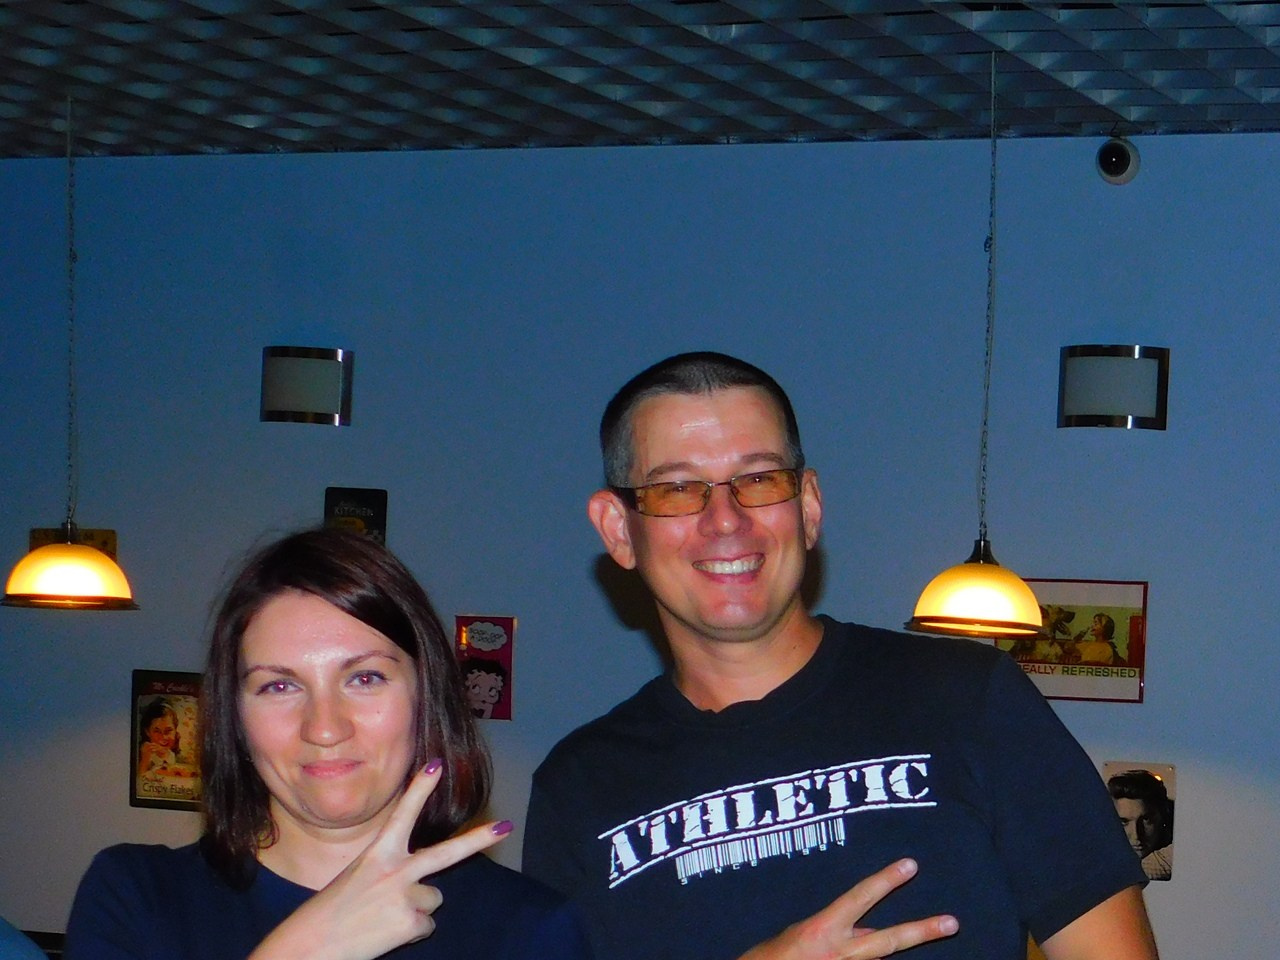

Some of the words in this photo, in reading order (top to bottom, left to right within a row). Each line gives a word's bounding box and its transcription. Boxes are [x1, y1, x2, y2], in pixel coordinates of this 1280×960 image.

[1061, 665, 1138, 678] REFRESHED
[608, 761, 930, 880] ATHLETIC
[681, 859, 758, 886] SINCE
